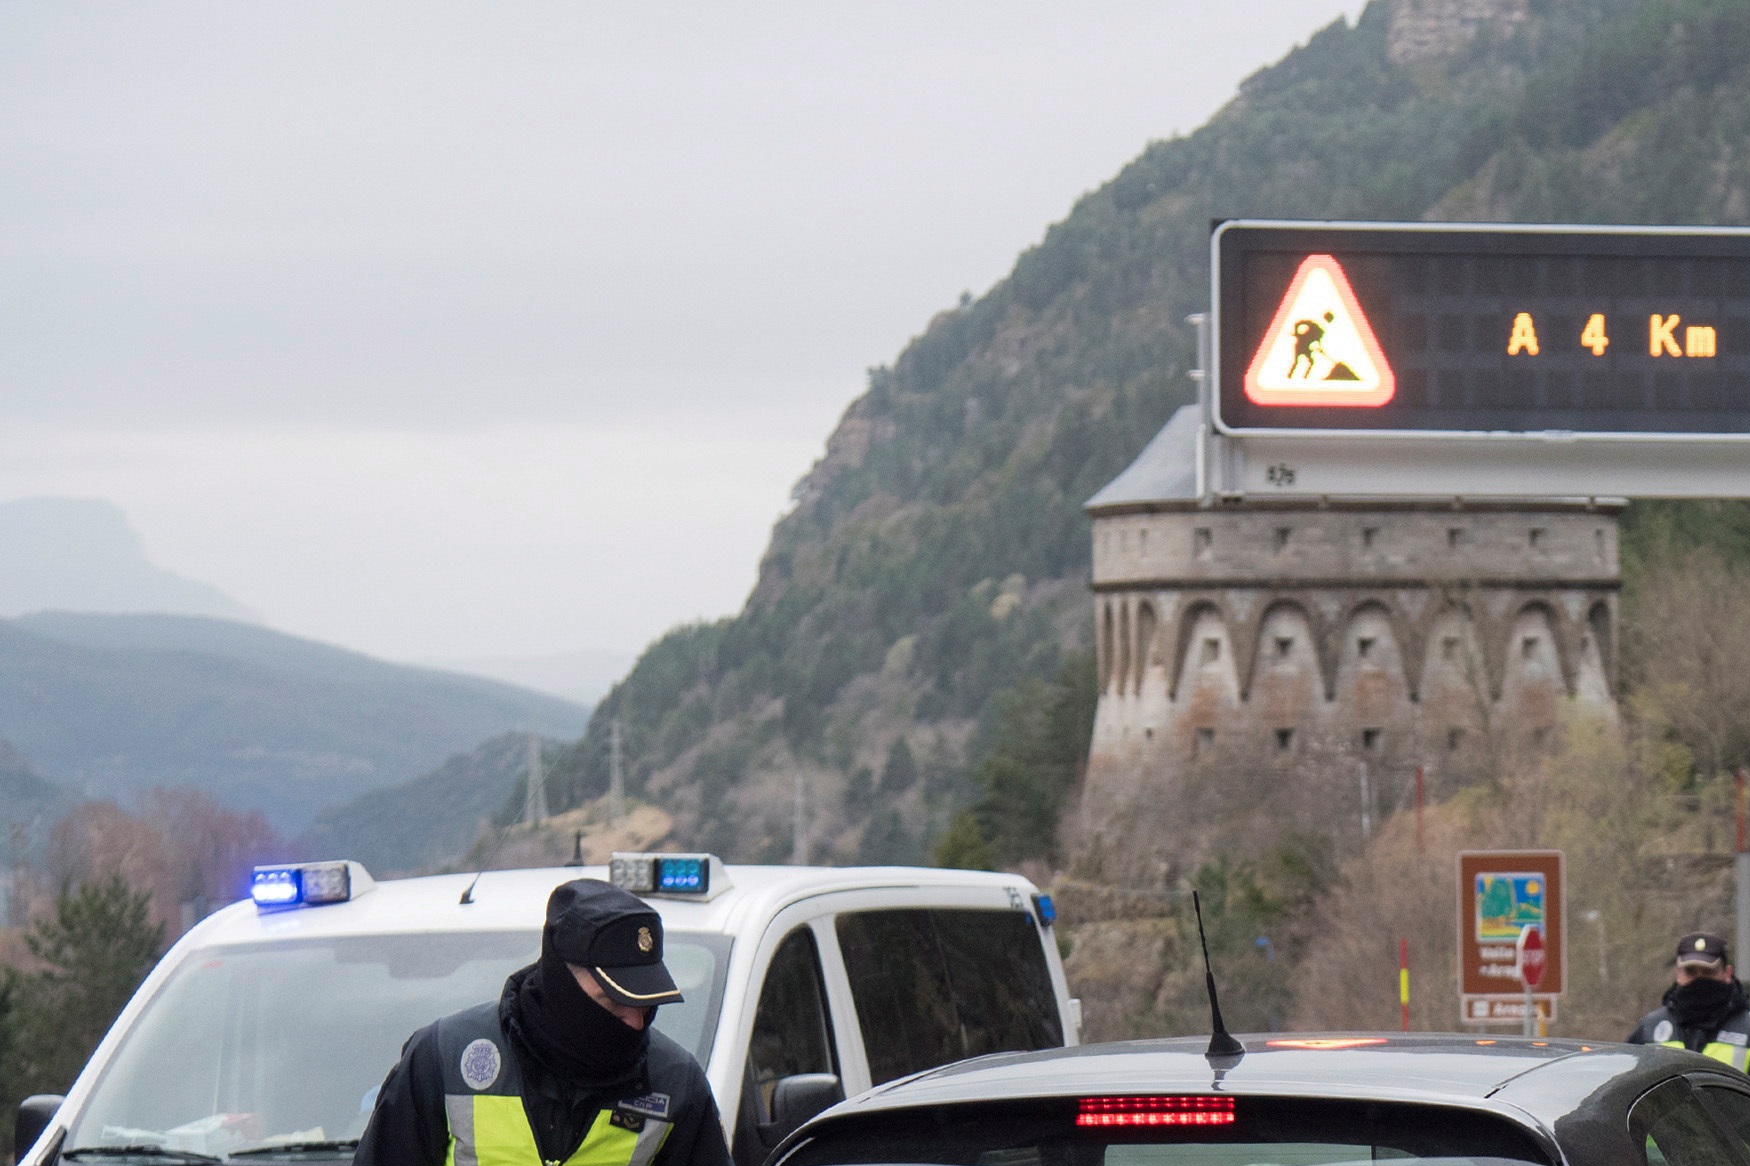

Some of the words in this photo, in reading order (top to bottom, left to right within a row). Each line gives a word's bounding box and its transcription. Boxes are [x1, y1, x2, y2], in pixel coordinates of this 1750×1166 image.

[1507, 312, 1540, 356] A
[1581, 313, 1609, 356] 4
[1650, 313, 1716, 357] Km
